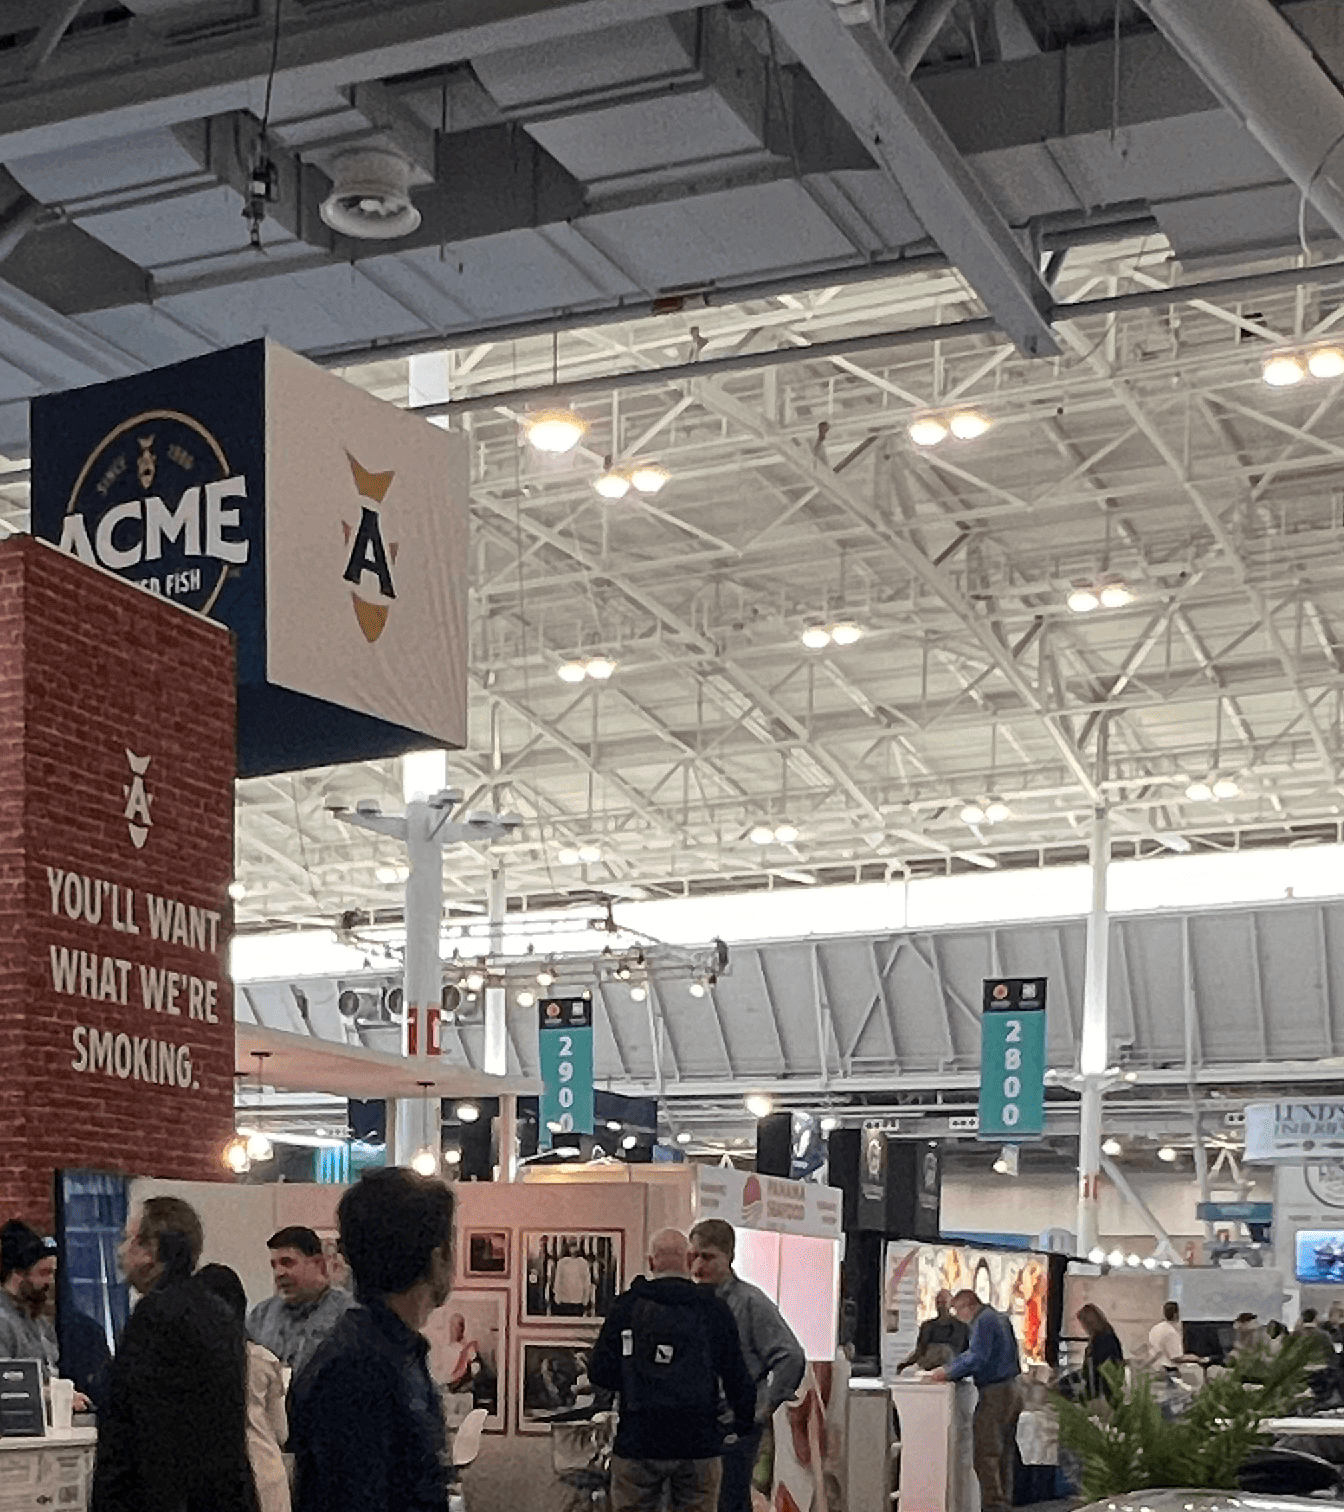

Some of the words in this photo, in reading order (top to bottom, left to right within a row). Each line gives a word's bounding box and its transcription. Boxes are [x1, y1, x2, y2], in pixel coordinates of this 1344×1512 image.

[58, 475, 249, 569] ACME
[343, 506, 396, 599] A
[166, 568, 201, 596] FISH
[47, 866, 139, 934] YOU'LL
[146, 893, 220, 953] WANT
[50, 945, 131, 1006] WHAT
[139, 964, 218, 1024] WE'RE
[72, 1026, 200, 1089] SMOKING.
[558, 1036, 574, 1133] 2900
[1002, 1020, 1021, 1125] 2800
